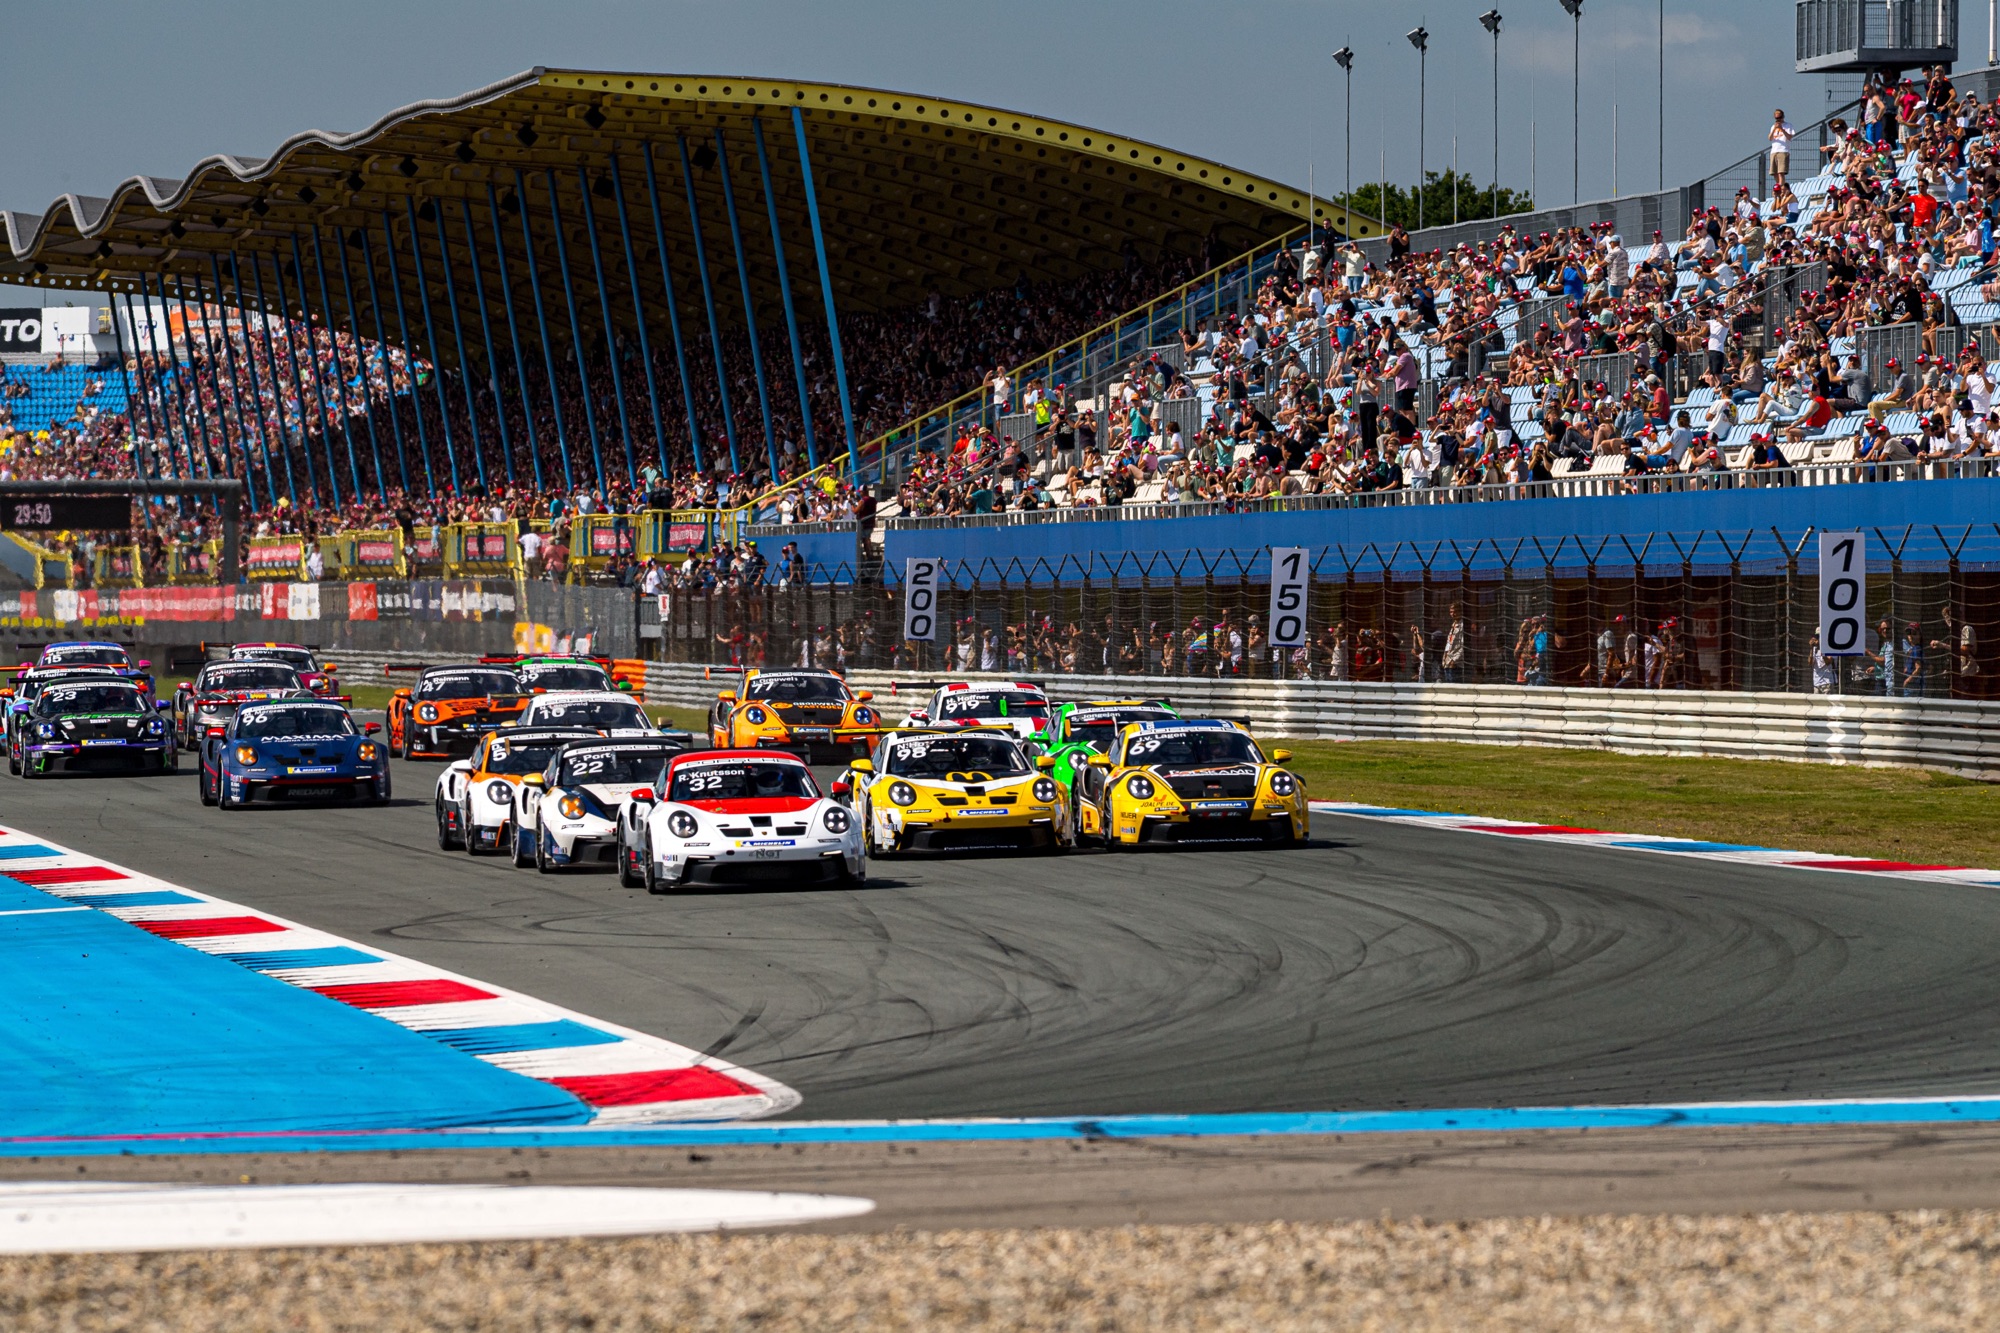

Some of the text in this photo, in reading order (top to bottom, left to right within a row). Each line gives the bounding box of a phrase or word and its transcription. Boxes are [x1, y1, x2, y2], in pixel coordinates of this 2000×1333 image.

[0, 319, 41, 342] TO
[910, 562, 933, 637] 200
[1275, 553, 1302, 642] 150
[1827, 538, 1859, 650] 100
[45, 655, 62, 664] 15
[208, 675, 224, 685] 11
[518, 672, 539, 684] 39
[422, 682, 446, 692] 47
[751, 682, 775, 694] 77
[52, 691, 77, 702] 23
[540, 707, 565, 720] 10
[945, 700, 980, 714] 919
[242, 715, 267, 726] 96
[1129, 740, 1160, 755] 69
[493, 749, 507, 761] 5
[569, 756, 582, 765] F.
[897, 748, 927, 761] 98
[572, 761, 604, 776] 22
[678, 769, 745, 783] R. Knutsson
[689, 777, 723, 792] 32
